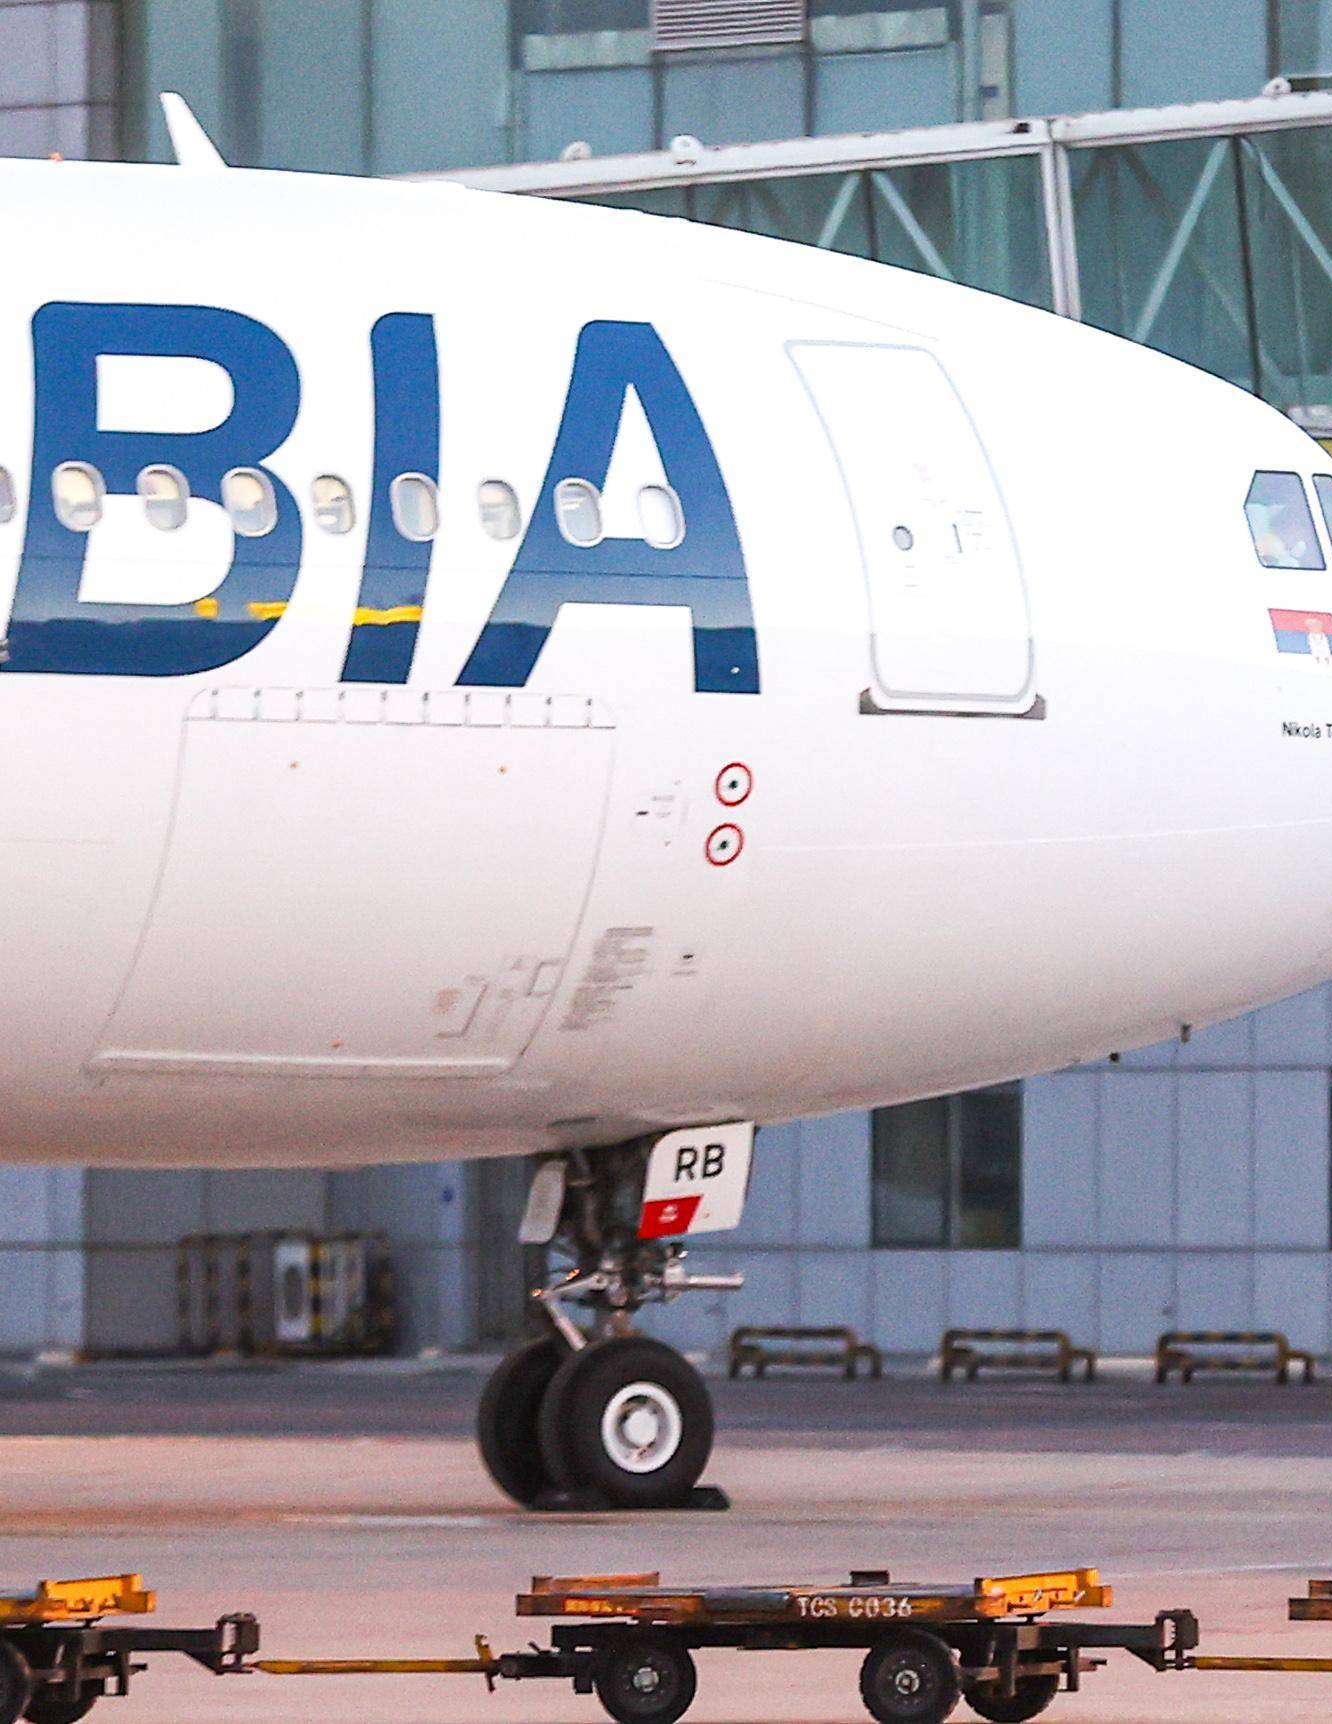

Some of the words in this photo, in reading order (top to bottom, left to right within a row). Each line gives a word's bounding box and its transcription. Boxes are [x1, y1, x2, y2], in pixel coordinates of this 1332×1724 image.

[0, 301, 762, 695] BIA
[1282, 721, 1321, 739] Nikola
[674, 1144, 726, 1183] RB
[798, 1597, 838, 1618] TCS
[848, 1597, 912, 1618] C036
